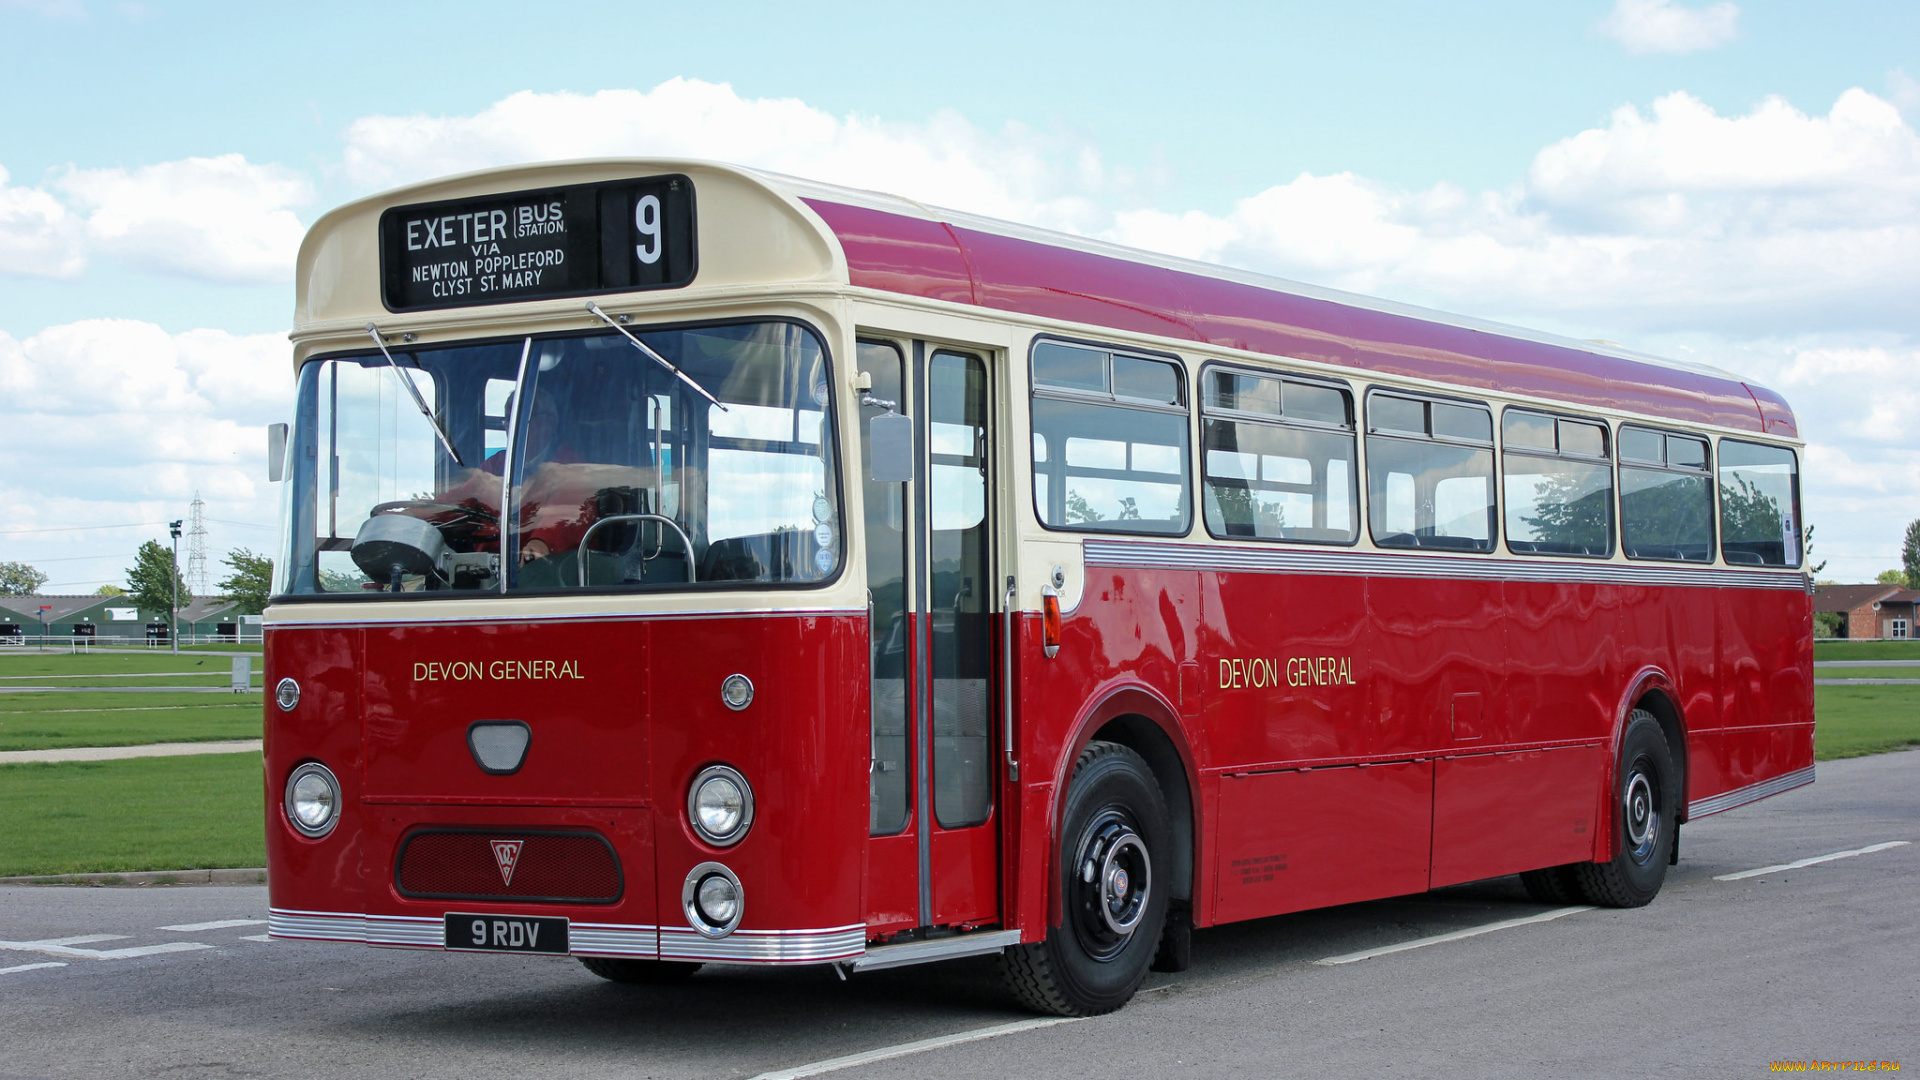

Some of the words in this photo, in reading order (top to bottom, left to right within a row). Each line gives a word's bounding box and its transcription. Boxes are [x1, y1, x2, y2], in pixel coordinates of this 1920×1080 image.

[407, 210, 507, 250] EXETER
[518, 202, 563, 224] BUS
[636, 195, 662, 264] 9
[471, 243, 501, 257] VIA
[412, 261, 468, 282] NEWTON
[475, 249, 564, 275] POPPLEFORD
[432, 278, 473, 297] CLYST
[480, 275, 499, 292] ST.
[502, 269, 543, 289] MARY
[413, 661, 483, 681] DEVON
[489, 660, 585, 680] GENERAL
[1219, 658, 1278, 689] DEVON
[1286, 656, 1356, 687] GENERAL
[471, 920, 486, 945] 9
[493, 921, 540, 948] RDV
